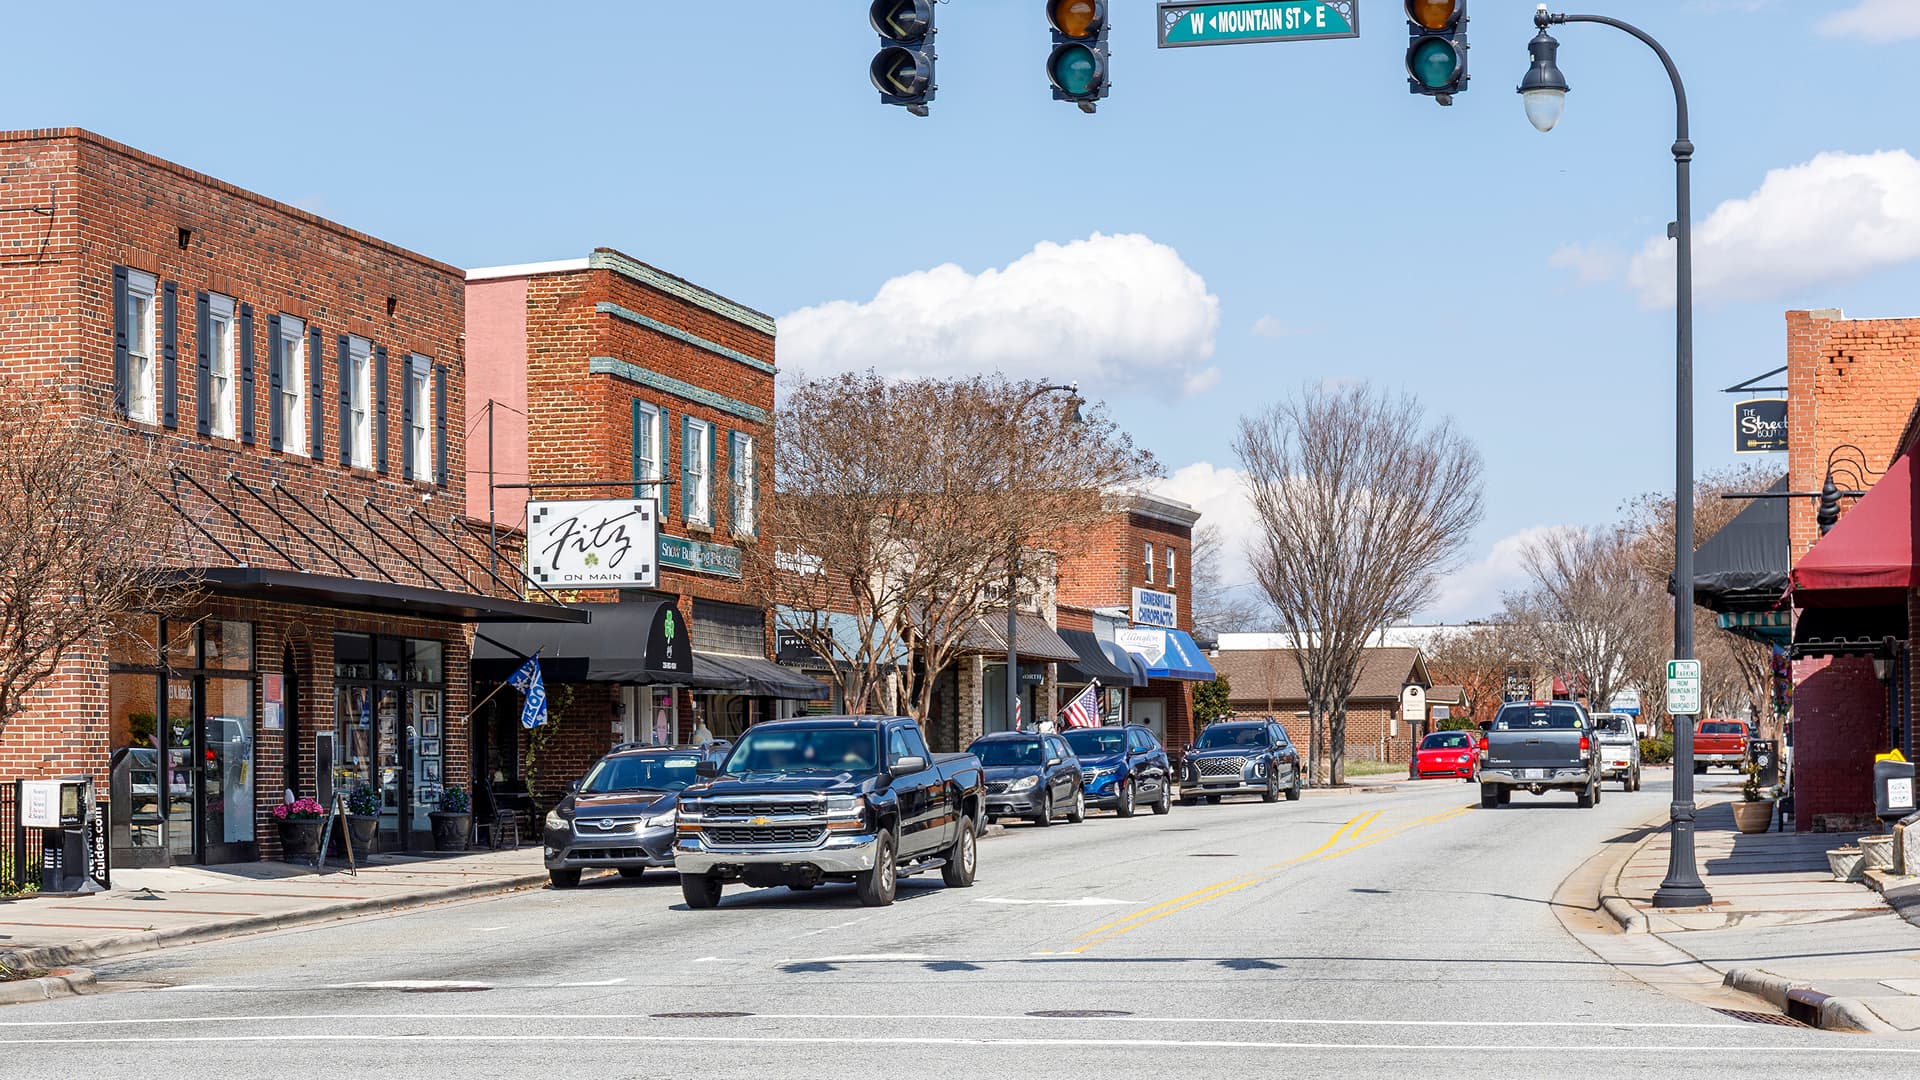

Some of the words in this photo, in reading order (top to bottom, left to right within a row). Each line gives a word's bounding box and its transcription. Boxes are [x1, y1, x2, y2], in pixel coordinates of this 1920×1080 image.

[1190, 12, 1204, 34] W
[1218, 9, 1283, 33] MOUNTAIN
[1285, 7, 1301, 30] ST
[1315, 6, 1326, 28] E
[1741, 415, 1788, 434] Street
[542, 511, 638, 570] Fitz
[661, 542, 681, 558] Snow
[589, 573, 622, 581] MAIN
[1140, 591, 1171, 609] KERNERSVILLE
[1139, 606, 1173, 626] CHIROPRACTIC
[94, 806, 105, 881] Guides.com
